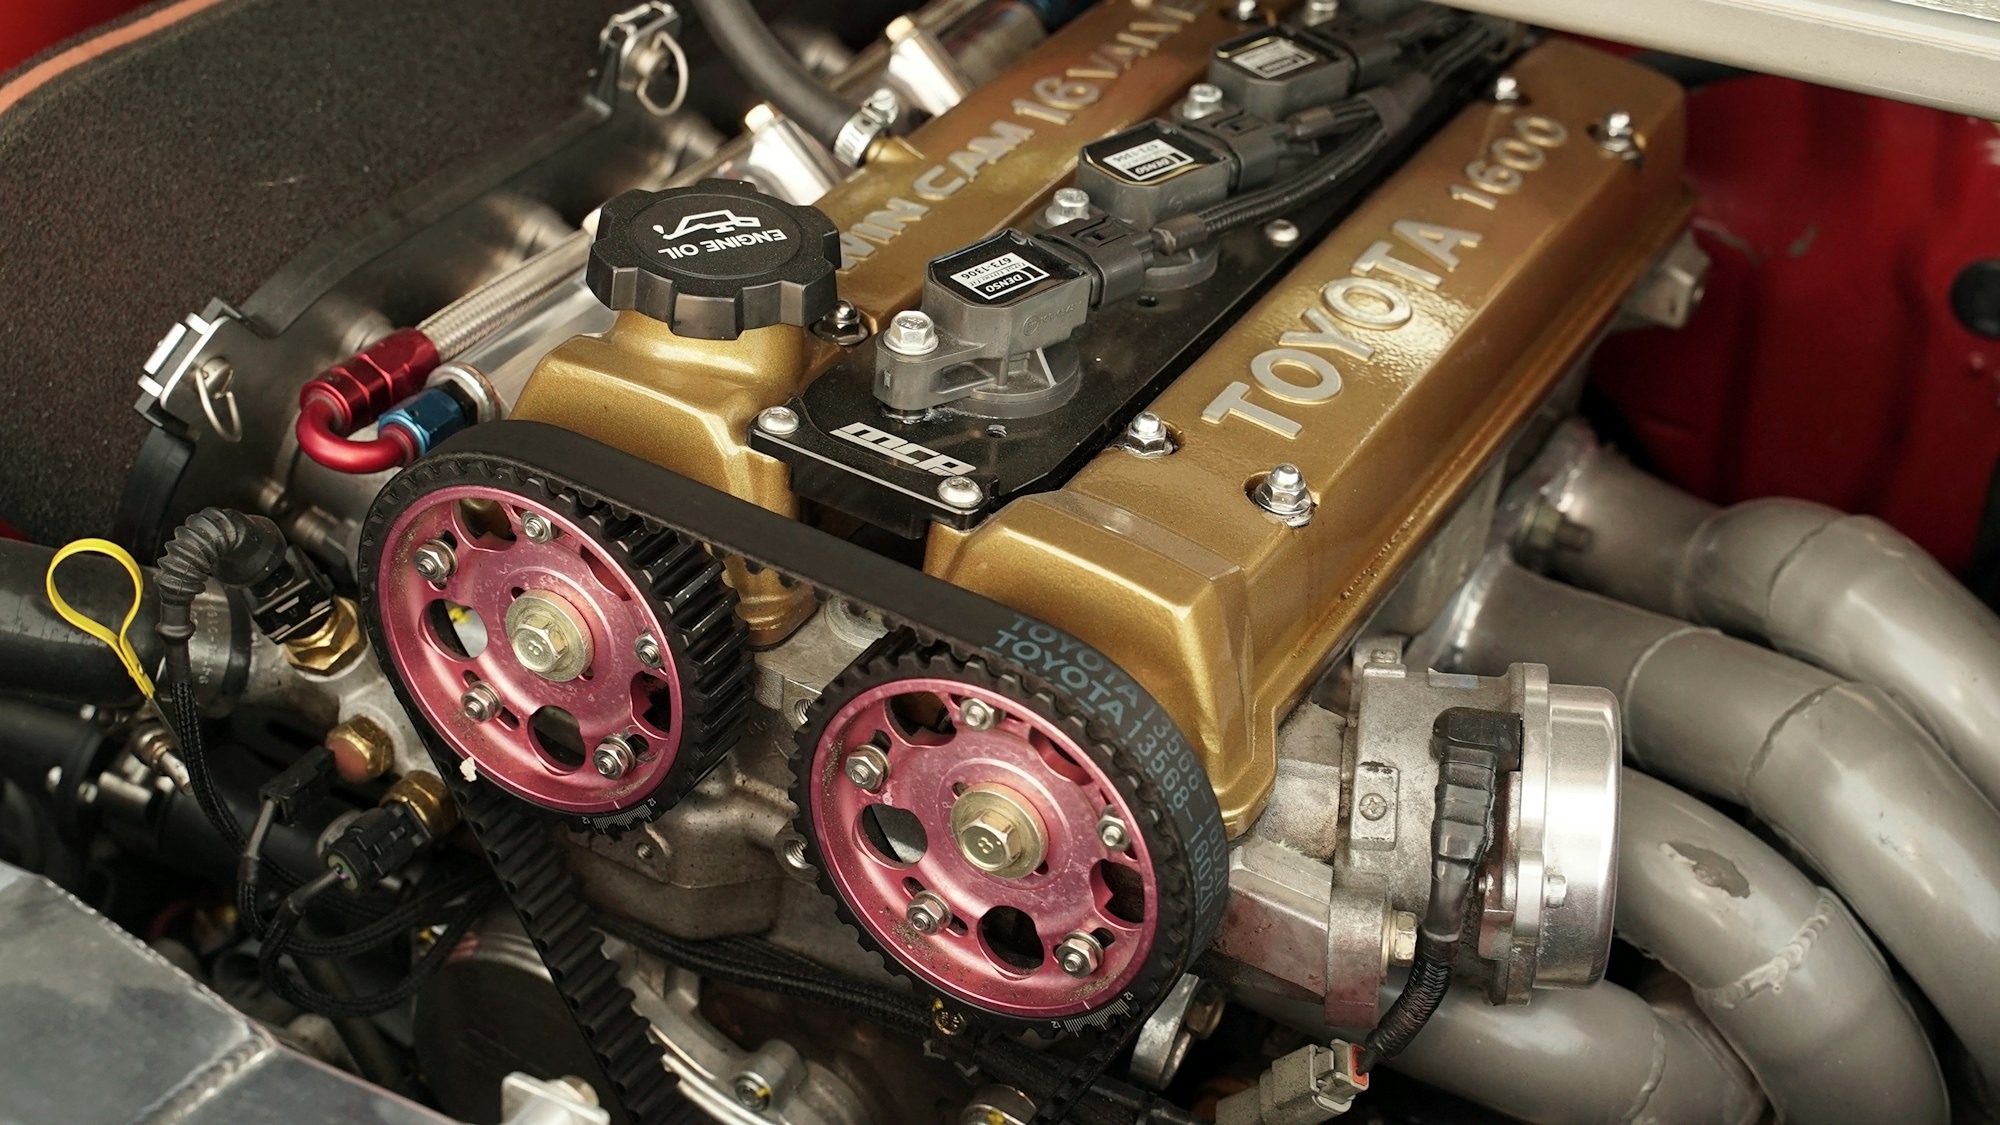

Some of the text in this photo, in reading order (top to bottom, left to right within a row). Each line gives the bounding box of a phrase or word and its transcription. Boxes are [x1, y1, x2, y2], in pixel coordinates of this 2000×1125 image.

[658, 229, 788, 260] ENGINE OIL
[837, 197, 930, 276] WIN
[913, 120, 1035, 200] CAM
[961, 257, 1013, 280] 673-1306
[985, 273, 1024, 294] DENSO
[1201, 115, 1568, 440] TOYOTA 1600
[1010, 613, 1143, 709] TOYOTA
[994, 629, 1124, 726] TOYOTA
[1127, 720, 1214, 914] 13568-16020
